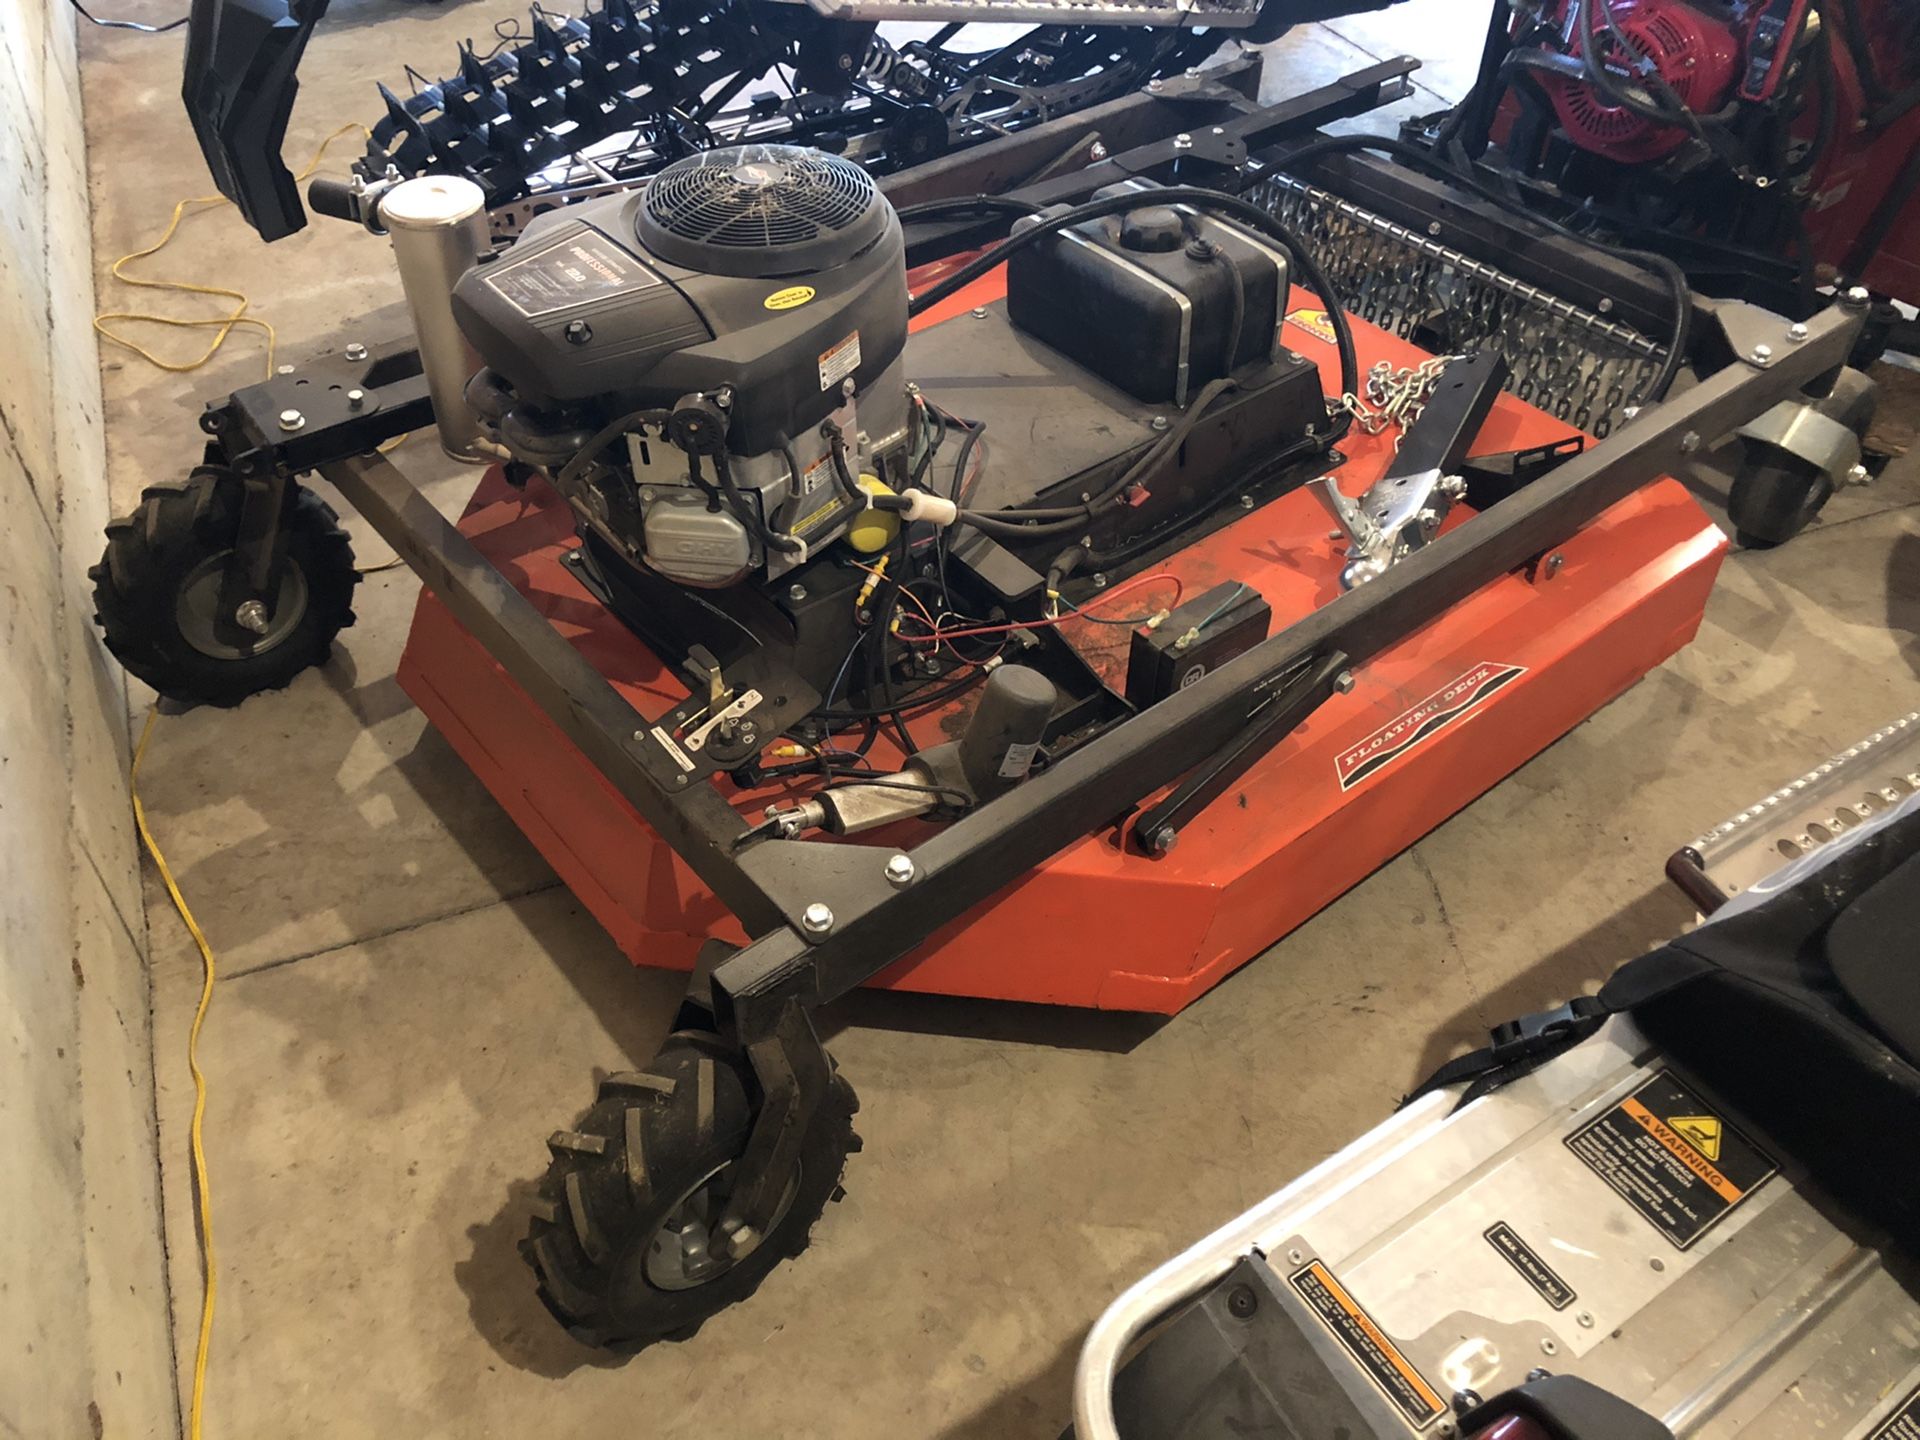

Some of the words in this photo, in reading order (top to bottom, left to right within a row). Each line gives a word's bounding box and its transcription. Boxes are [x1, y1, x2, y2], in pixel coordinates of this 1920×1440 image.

[569, 246, 625, 286] PROFESSIONAL
[1345, 700, 1439, 766] FLOATING
[1443, 668, 1490, 702] DECK
[1602, 1120, 1619, 1136] Burn
[1619, 1136, 1634, 1149] may
[1655, 1126, 1722, 1186] WARNING
[1595, 1160, 1605, 1170] by
[1606, 1152, 1621, 1165] only
[1635, 1138, 1647, 1148] DO
[1648, 1149, 1664, 1162] NOT
[1665, 1163, 1691, 1187] TOUCH
[1643, 1136, 1660, 1149] HOT
[1660, 1150, 1694, 1180] SURFACE
[1614, 1145, 1626, 1156] top
[1626, 1156, 1636, 1164] of
[1635, 1163, 1657, 1183] tunnel
[1657, 1184, 1673, 1198] may
[1673, 1198, 1684, 1208] be
[1683, 1207, 1697, 1220] hot.
[1617, 1172, 1651, 1201] approved
[1651, 1201, 1662, 1211] for
[1662, 1212, 1675, 1225] this
[1362, 1322, 1394, 1358] WARNING
